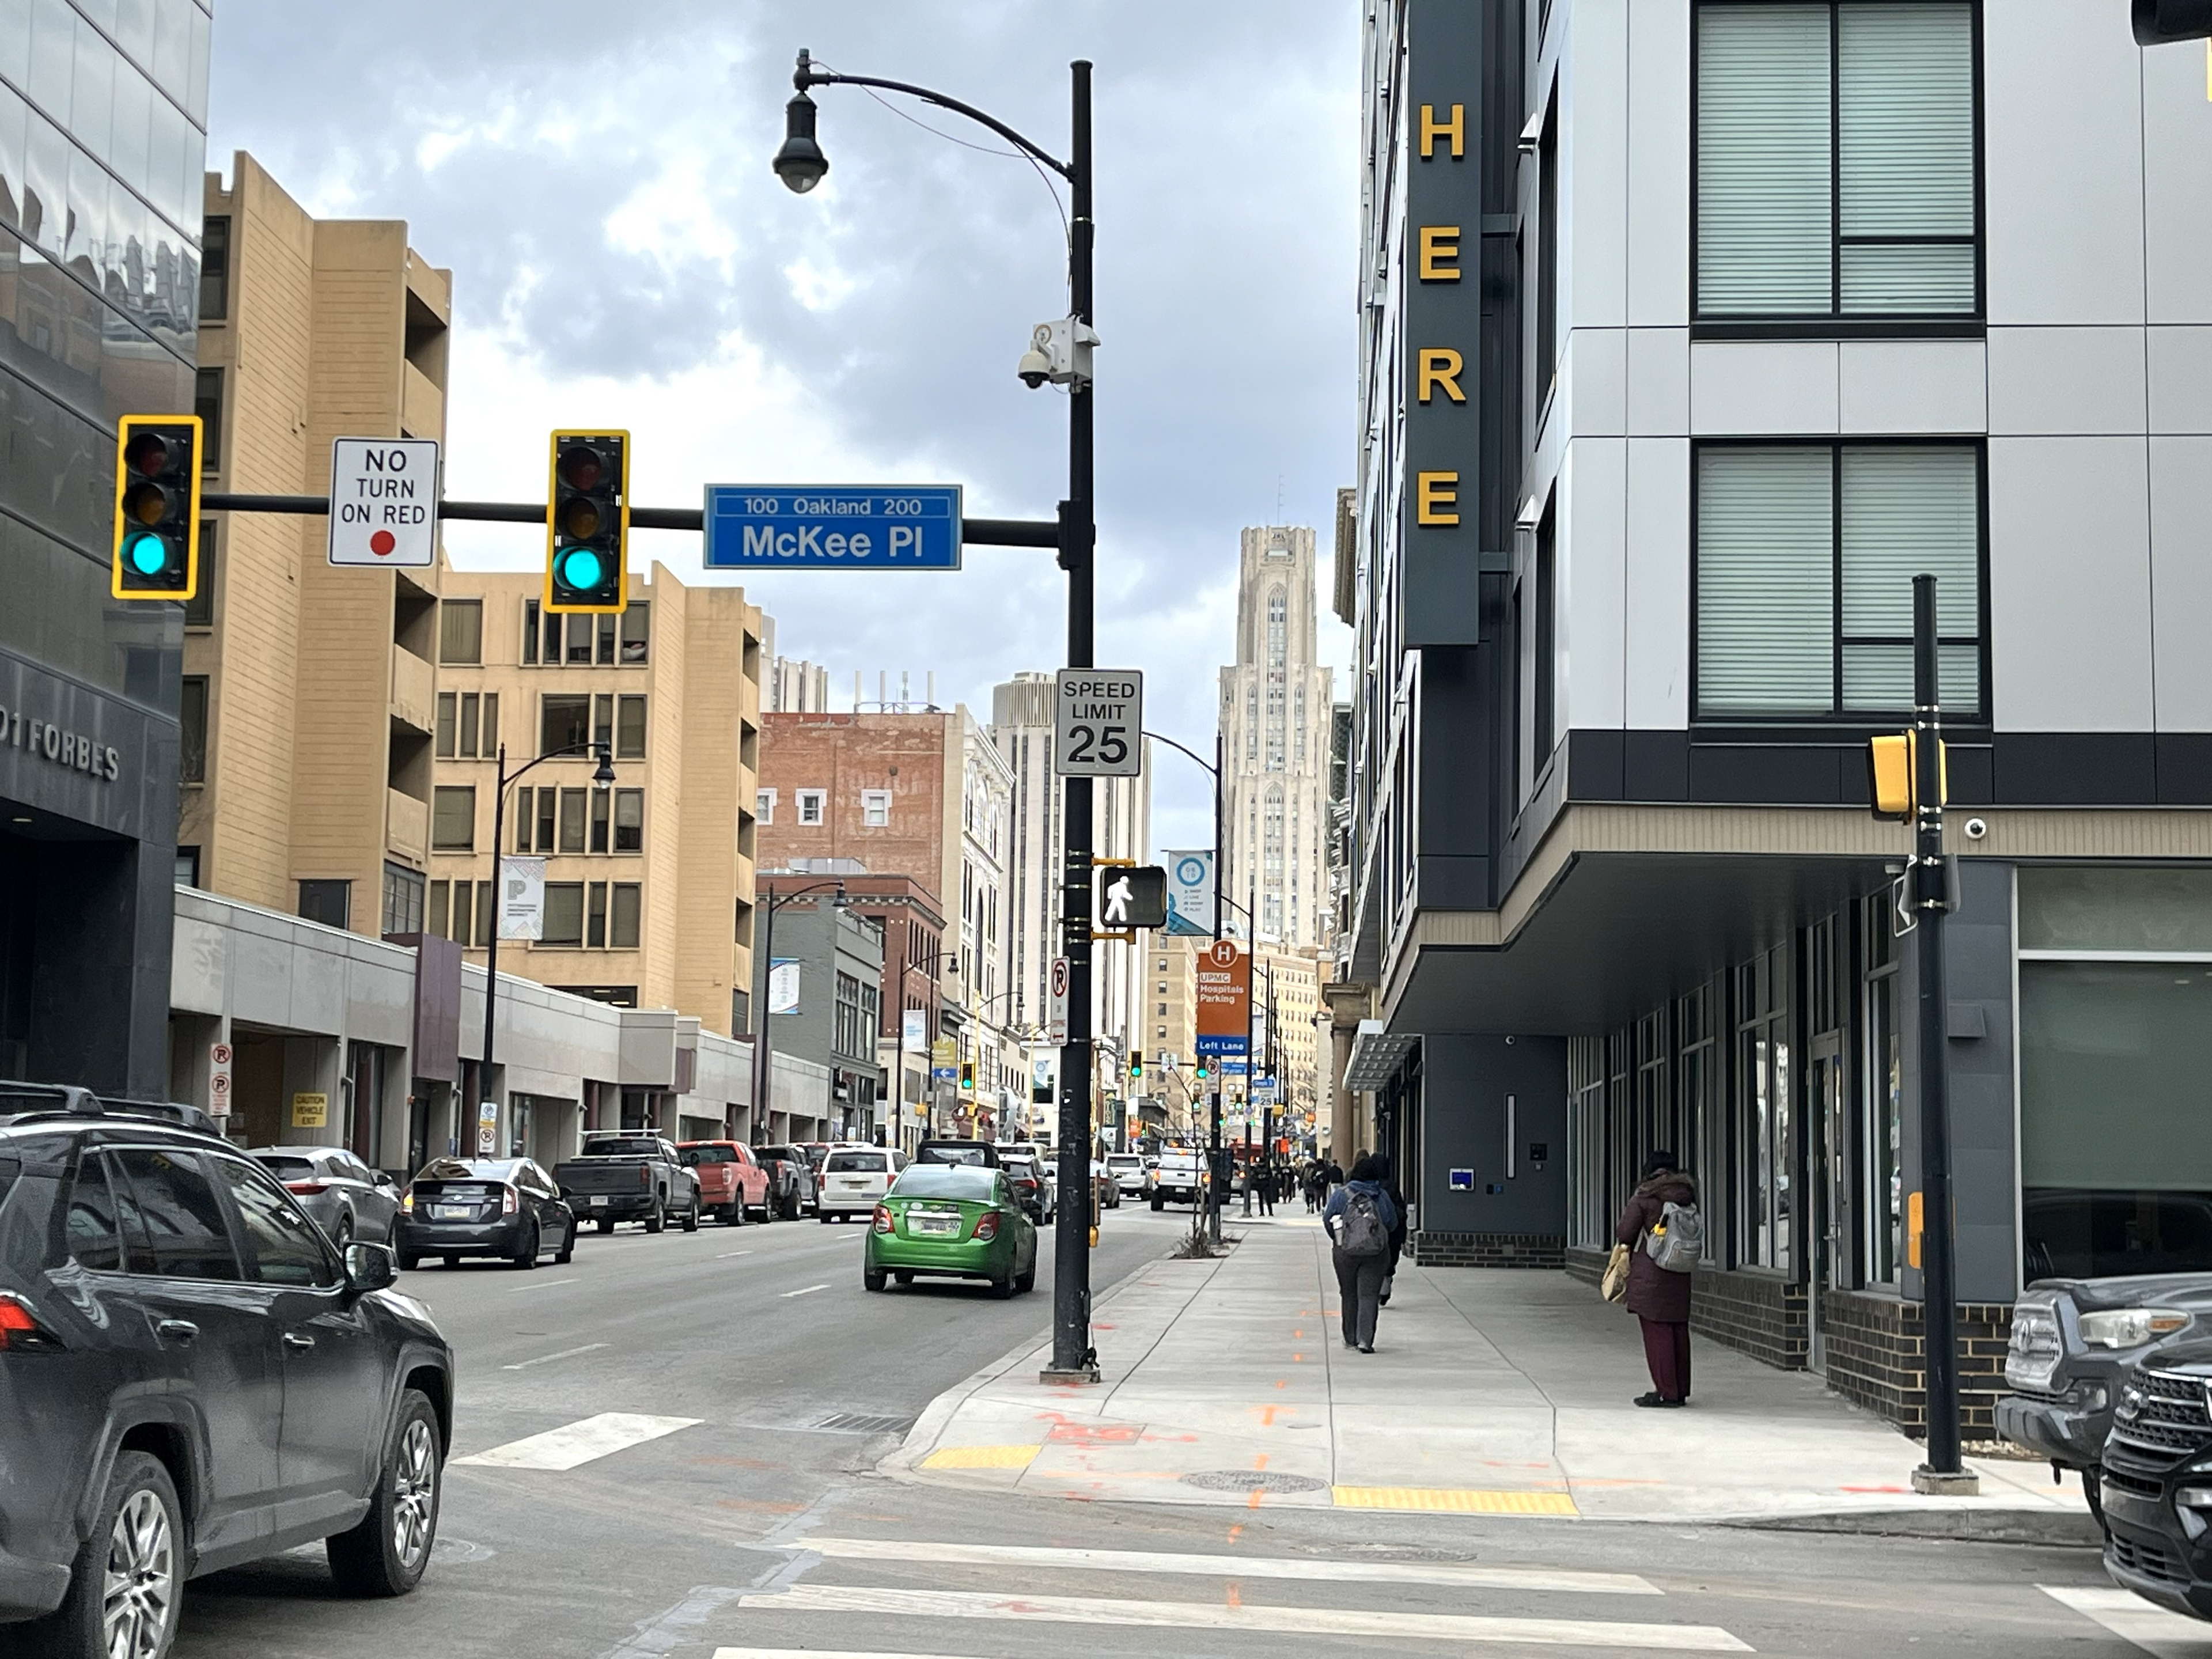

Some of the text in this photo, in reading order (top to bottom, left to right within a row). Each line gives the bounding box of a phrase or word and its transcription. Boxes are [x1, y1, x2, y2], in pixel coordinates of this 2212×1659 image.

[1418, 104, 1466, 525] HERE
[365, 449, 407, 472] NO
[356, 479, 414, 498] TURN
[342, 503, 425, 524] ON RED
[744, 497, 922, 515] 100 Oakland 200
[743, 525, 922, 557] McKee Pl
[1065, 681, 1135, 698] SPEED
[1073, 703, 1126, 719] LIMIT
[29, 718, 120, 781] FORBES
[1068, 725, 1128, 764] 25
[1217, 945, 1230, 961] H
[1200, 974, 1229, 982] UPMC
[1200, 984, 1244, 994] Hospitals
[1200, 994, 1236, 1005] Parking
[1199, 1040, 1244, 1050] Left Lane
[296, 1096, 324, 1104] CAUTION
[1260, 1097, 1272, 1105] 25
[296, 1106, 324, 1114] VEHICLE
